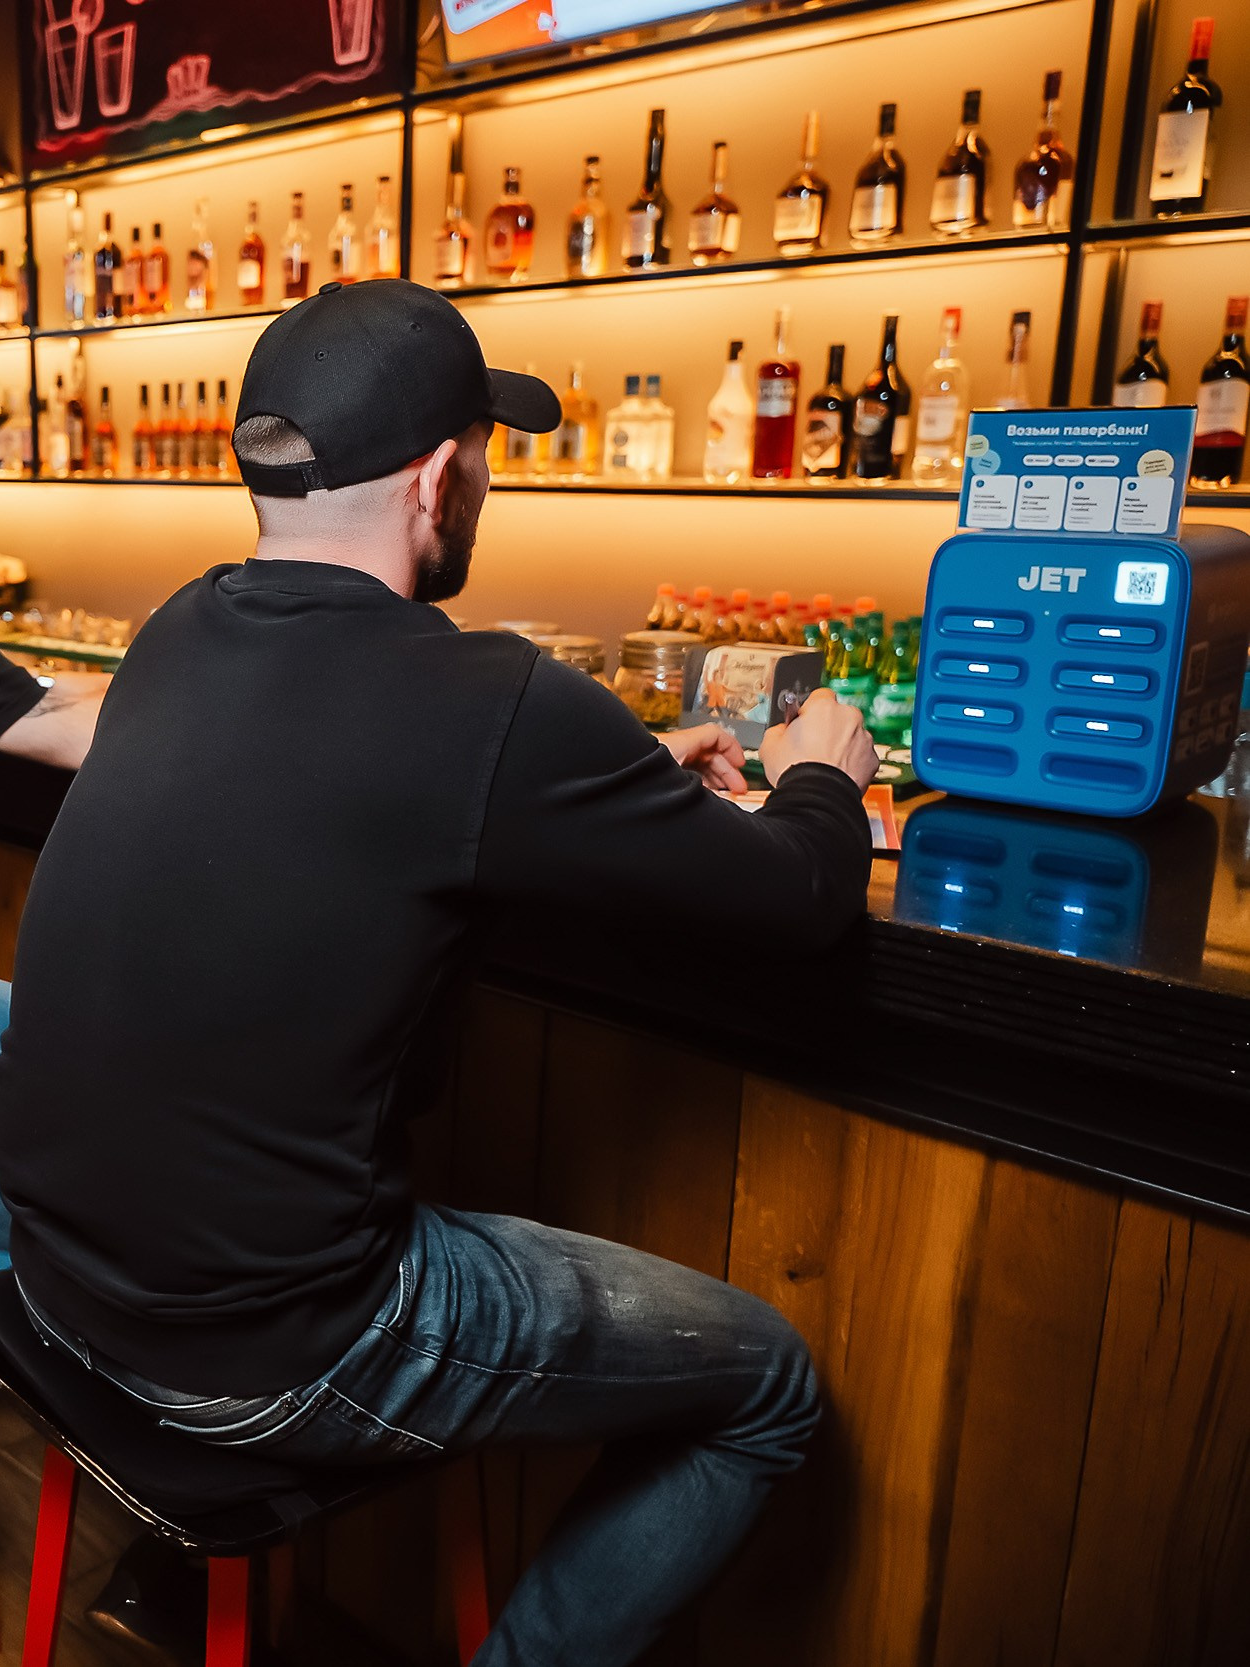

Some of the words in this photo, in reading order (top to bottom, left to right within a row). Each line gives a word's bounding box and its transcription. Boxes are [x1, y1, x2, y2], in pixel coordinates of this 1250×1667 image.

[1007, 425, 1060, 436] Возьми
[1063, 424, 1148, 438] павербанк!
[1018, 566, 1087, 593] JET
